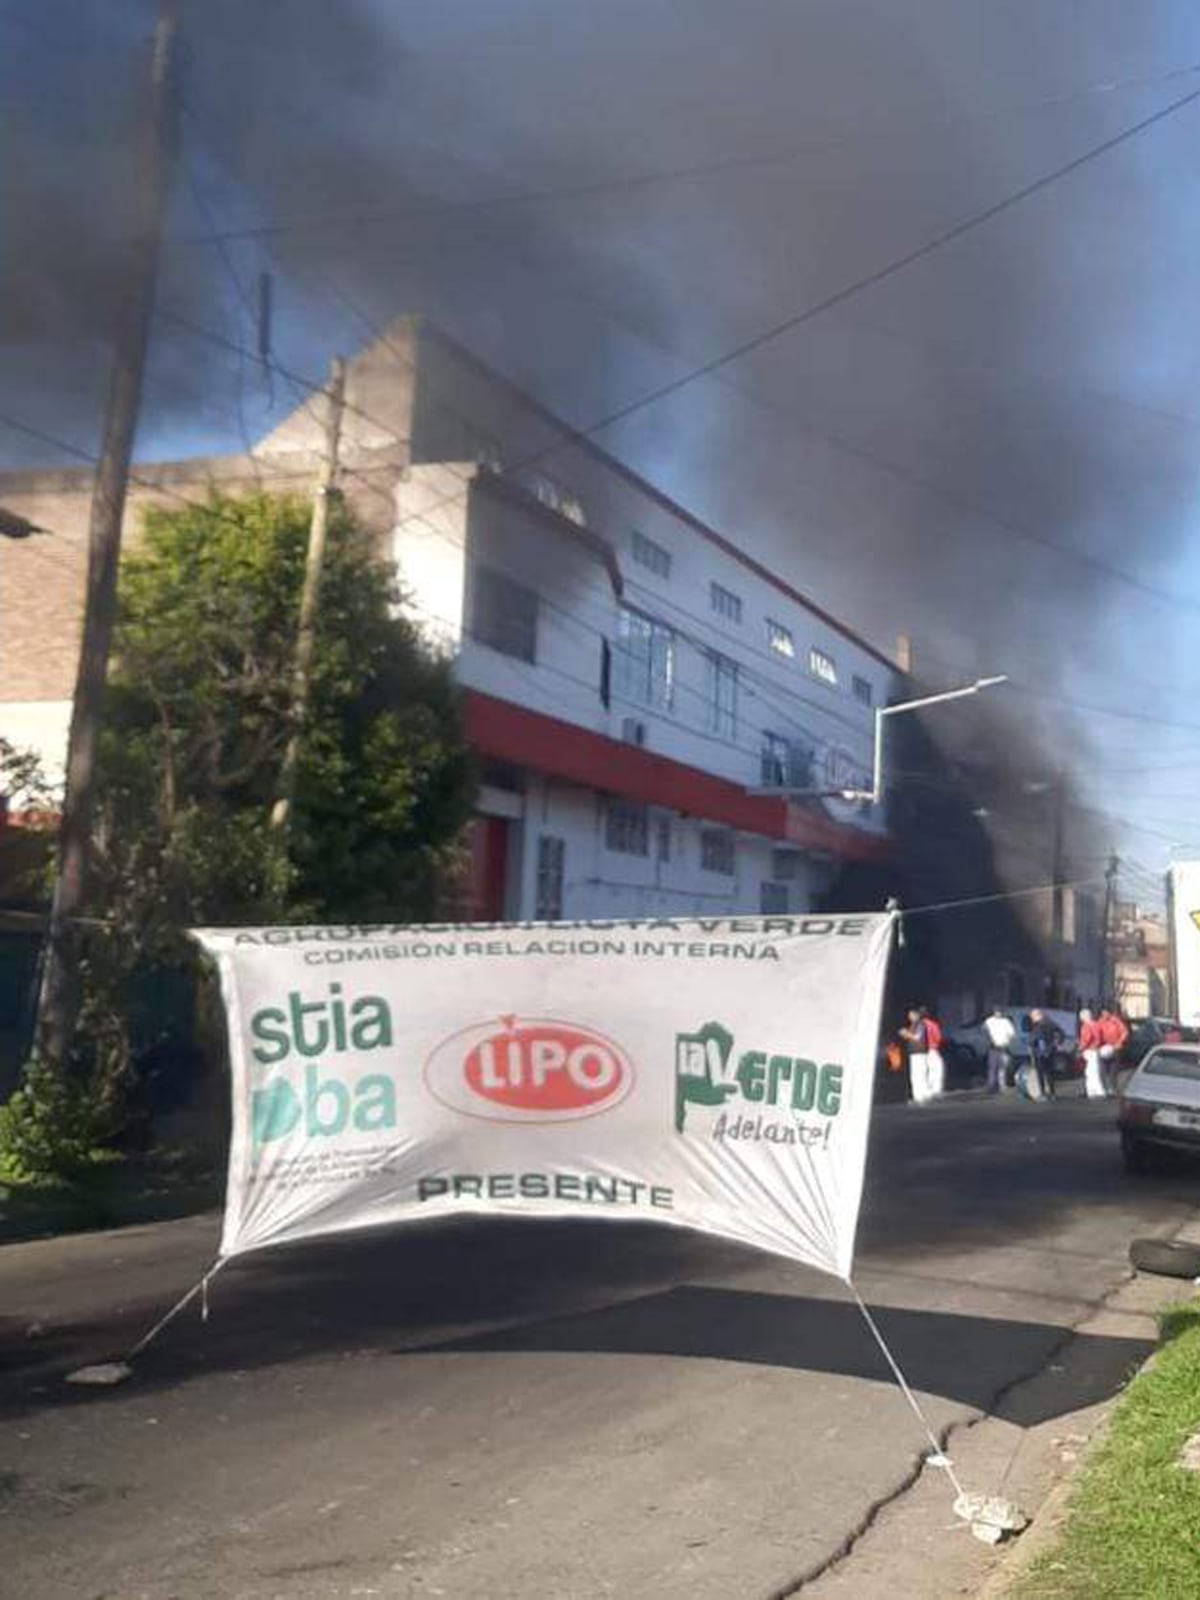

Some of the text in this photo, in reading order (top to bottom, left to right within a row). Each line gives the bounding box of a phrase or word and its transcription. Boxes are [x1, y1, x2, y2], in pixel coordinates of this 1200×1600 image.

[697, 917, 866, 936] VERDE
[633, 941, 780, 961] INTERNA
[250, 982, 393, 1065] stia
[479, 1037, 617, 1091] LIPO
[713, 1114, 831, 1150] Adelante!
[416, 1173, 675, 1210] PRESENTE
